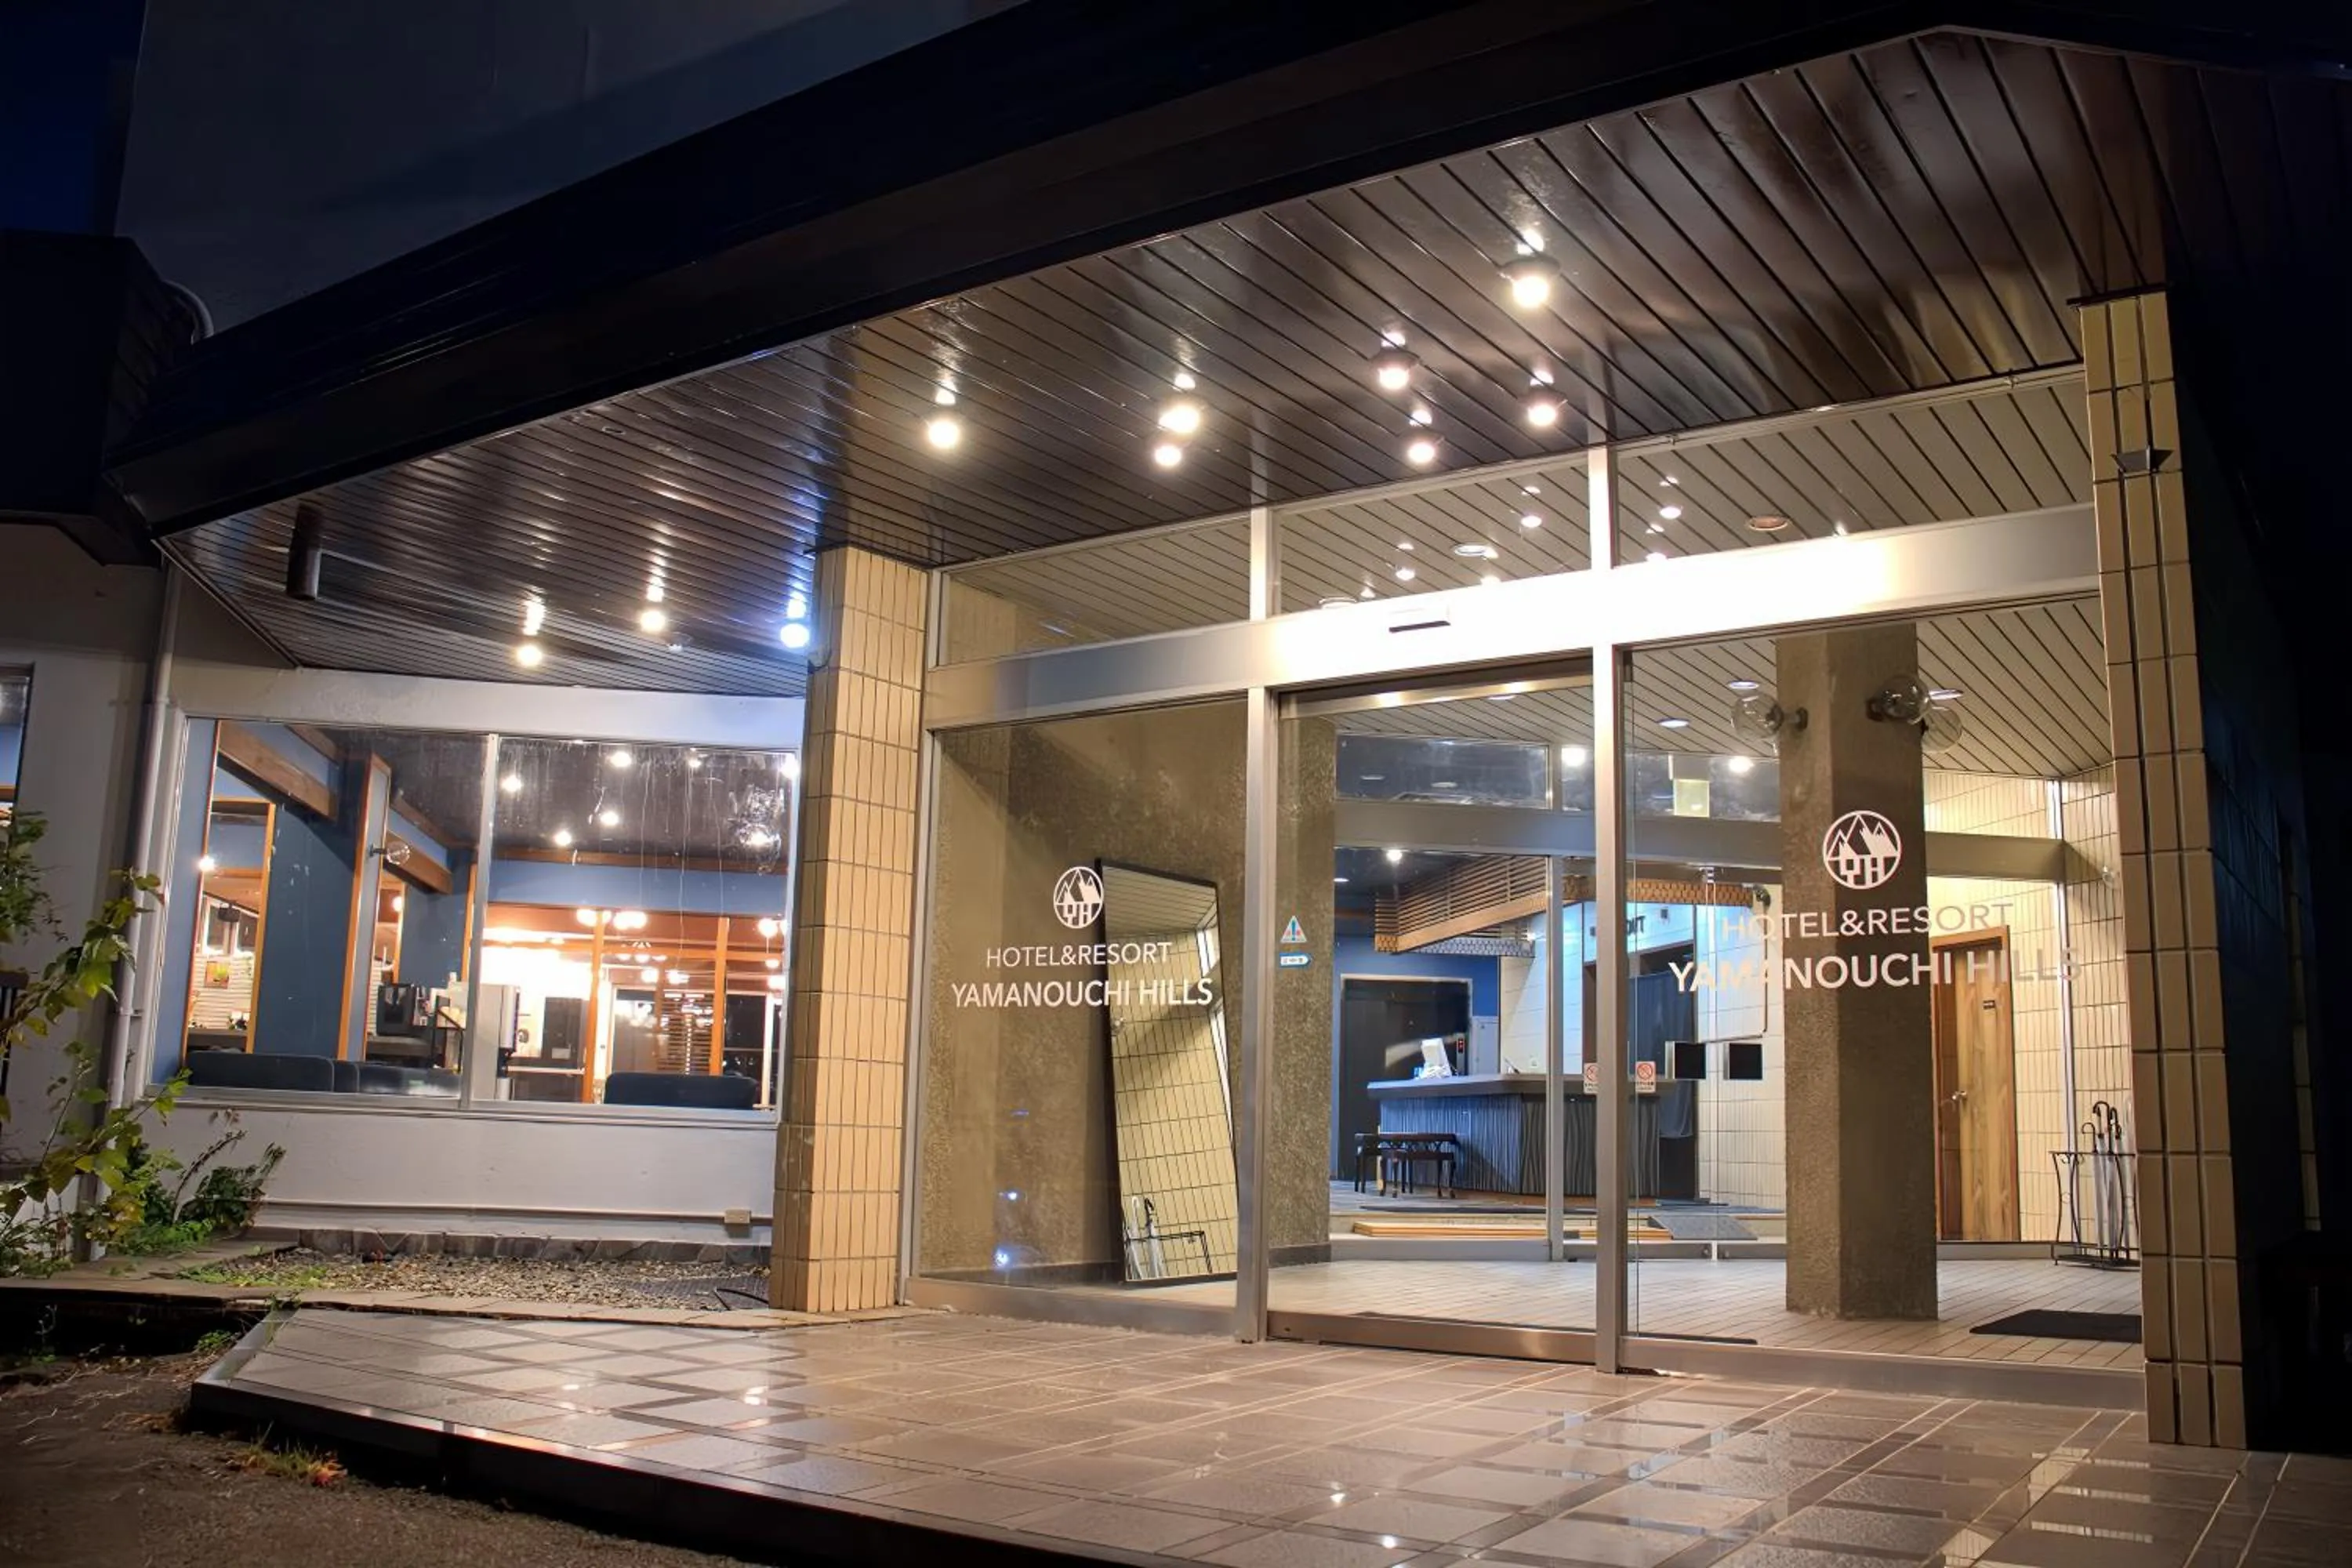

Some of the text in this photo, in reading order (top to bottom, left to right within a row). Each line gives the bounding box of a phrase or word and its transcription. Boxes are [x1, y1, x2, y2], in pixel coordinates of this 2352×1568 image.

[1722, 903, 2013, 940] HOTEL&RESORT
[986, 942, 1173, 967] HOTEL&RESORT
[1668, 947, 2082, 993] YAMNOUCHI HILLS
[951, 978, 1214, 1007] YAMANOUCHI HILLS
